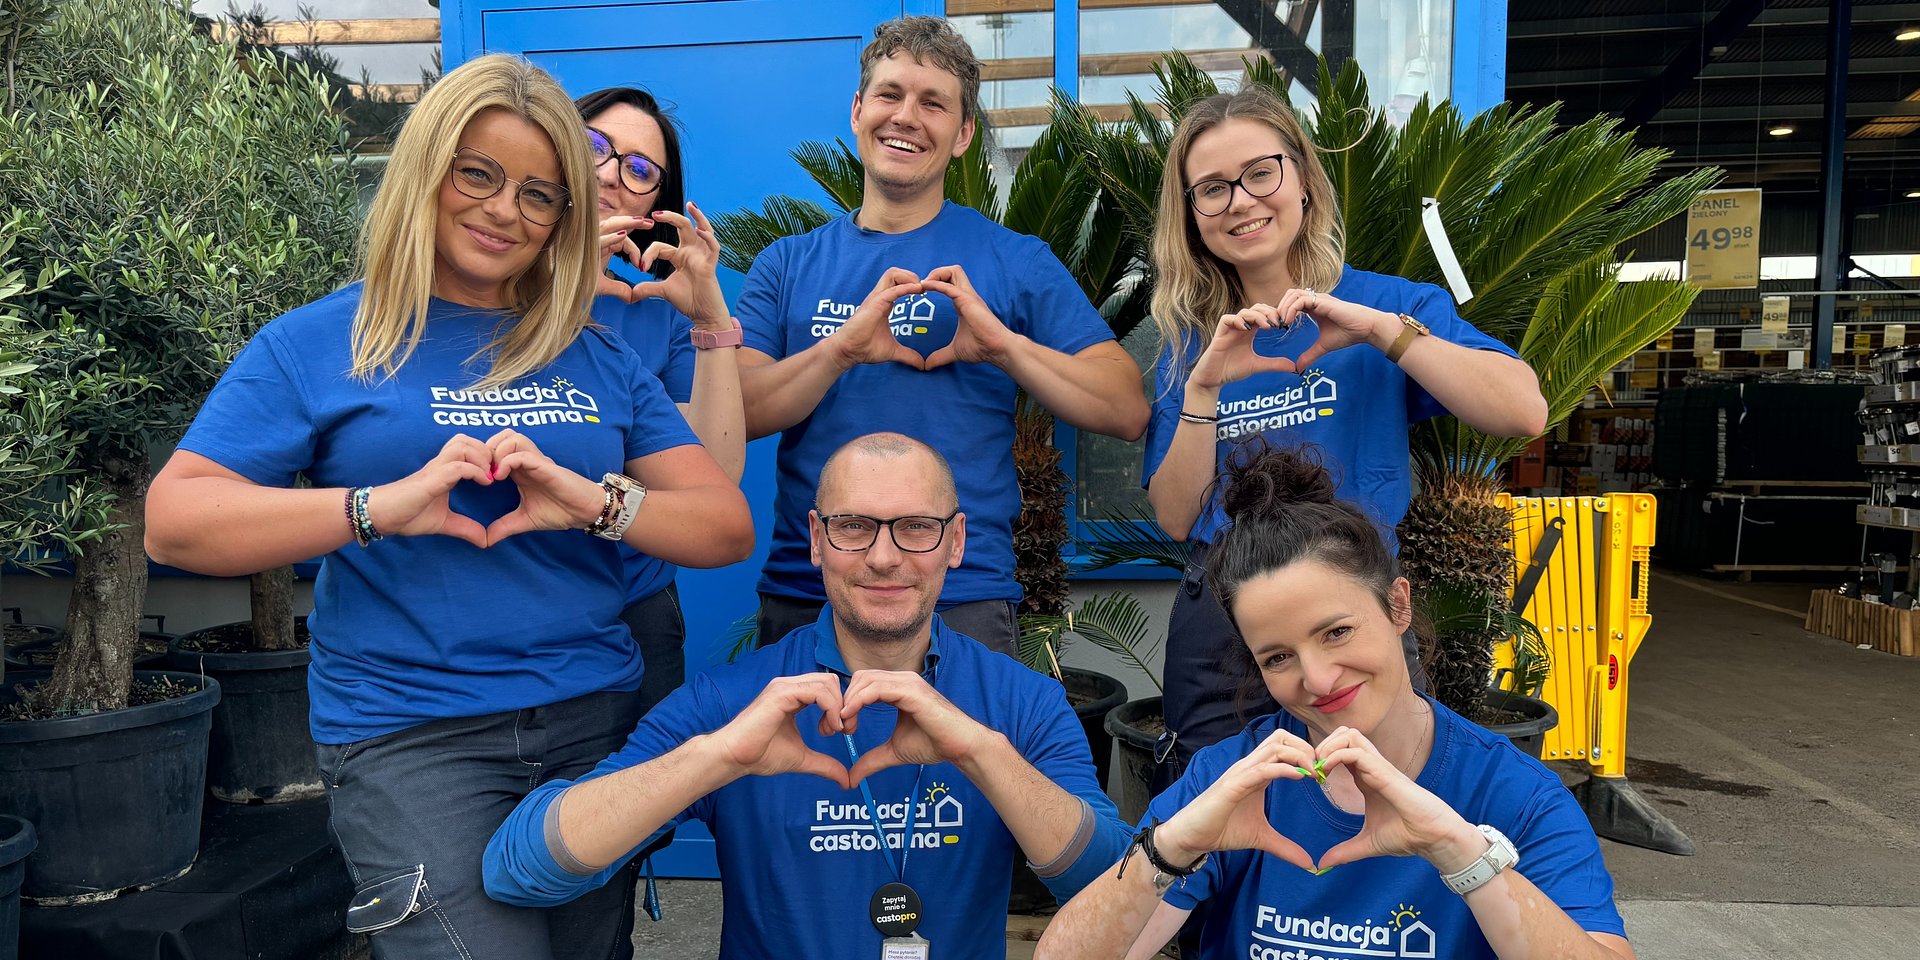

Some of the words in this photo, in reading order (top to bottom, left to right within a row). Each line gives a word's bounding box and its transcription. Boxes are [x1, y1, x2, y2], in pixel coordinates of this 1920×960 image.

[1692, 198, 1740, 210] PANEL
[1692, 210, 1728, 218] ZIELONY
[430, 382, 560, 403] Fundacja
[433, 410, 584, 427] castorama
[1217, 408, 1316, 441] astorama
[810, 831, 940, 852] castoama
[882, 895, 906, 904] Zapytaj
[876, 912, 917, 923] castopro
[1256, 905, 1390, 949] Fundacja
